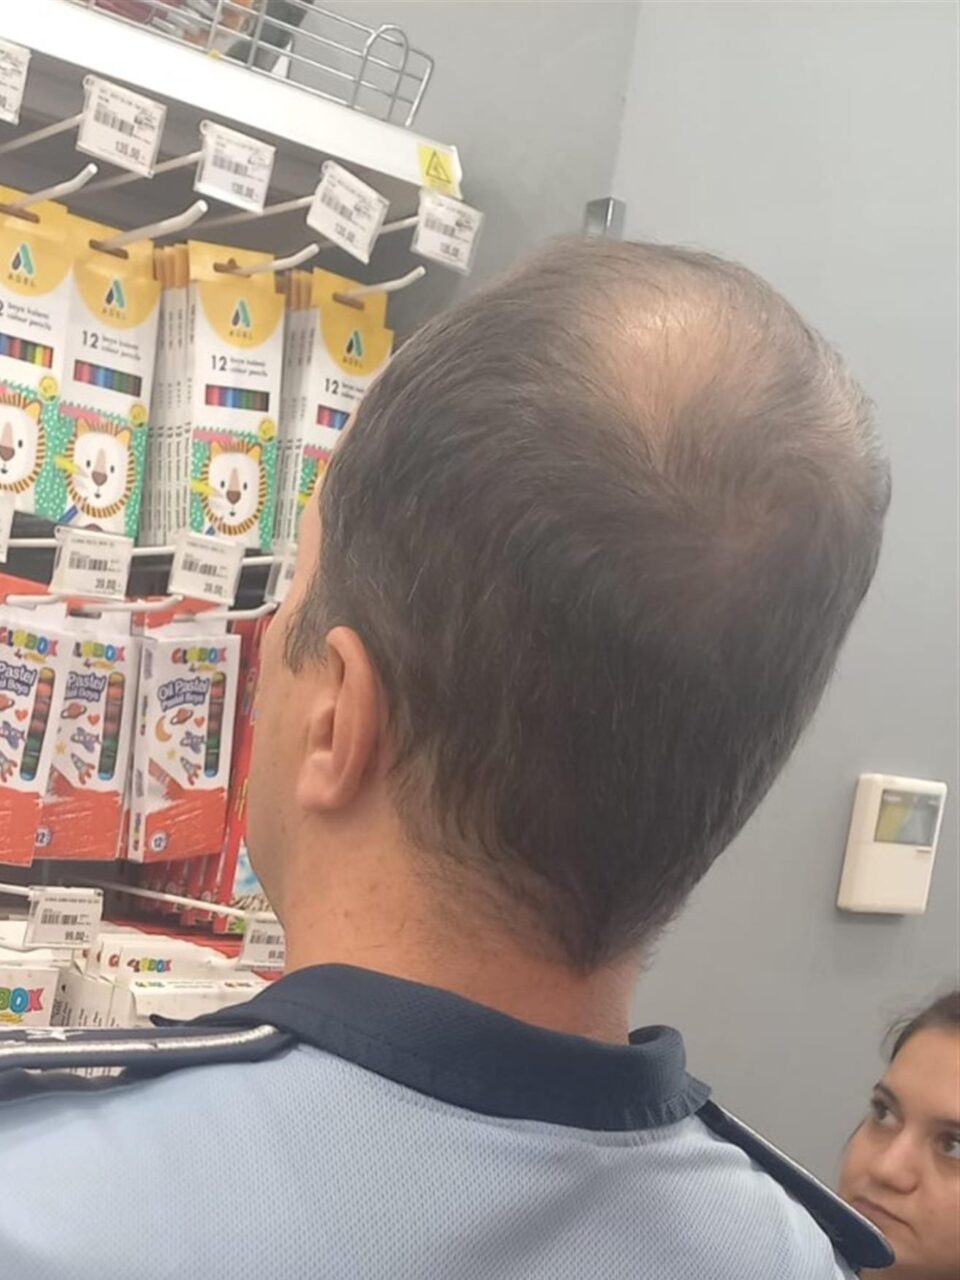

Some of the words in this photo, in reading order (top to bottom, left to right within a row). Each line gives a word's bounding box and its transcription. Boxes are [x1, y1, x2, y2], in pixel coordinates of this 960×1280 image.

[82, 331, 99, 348] 12
[211, 355, 228, 371] 12
[324, 378, 340, 394] 12
[171, 647, 227, 663] GLOBOX
[158, 683, 176, 700] Oil
[176, 678, 211, 695] Pastel
